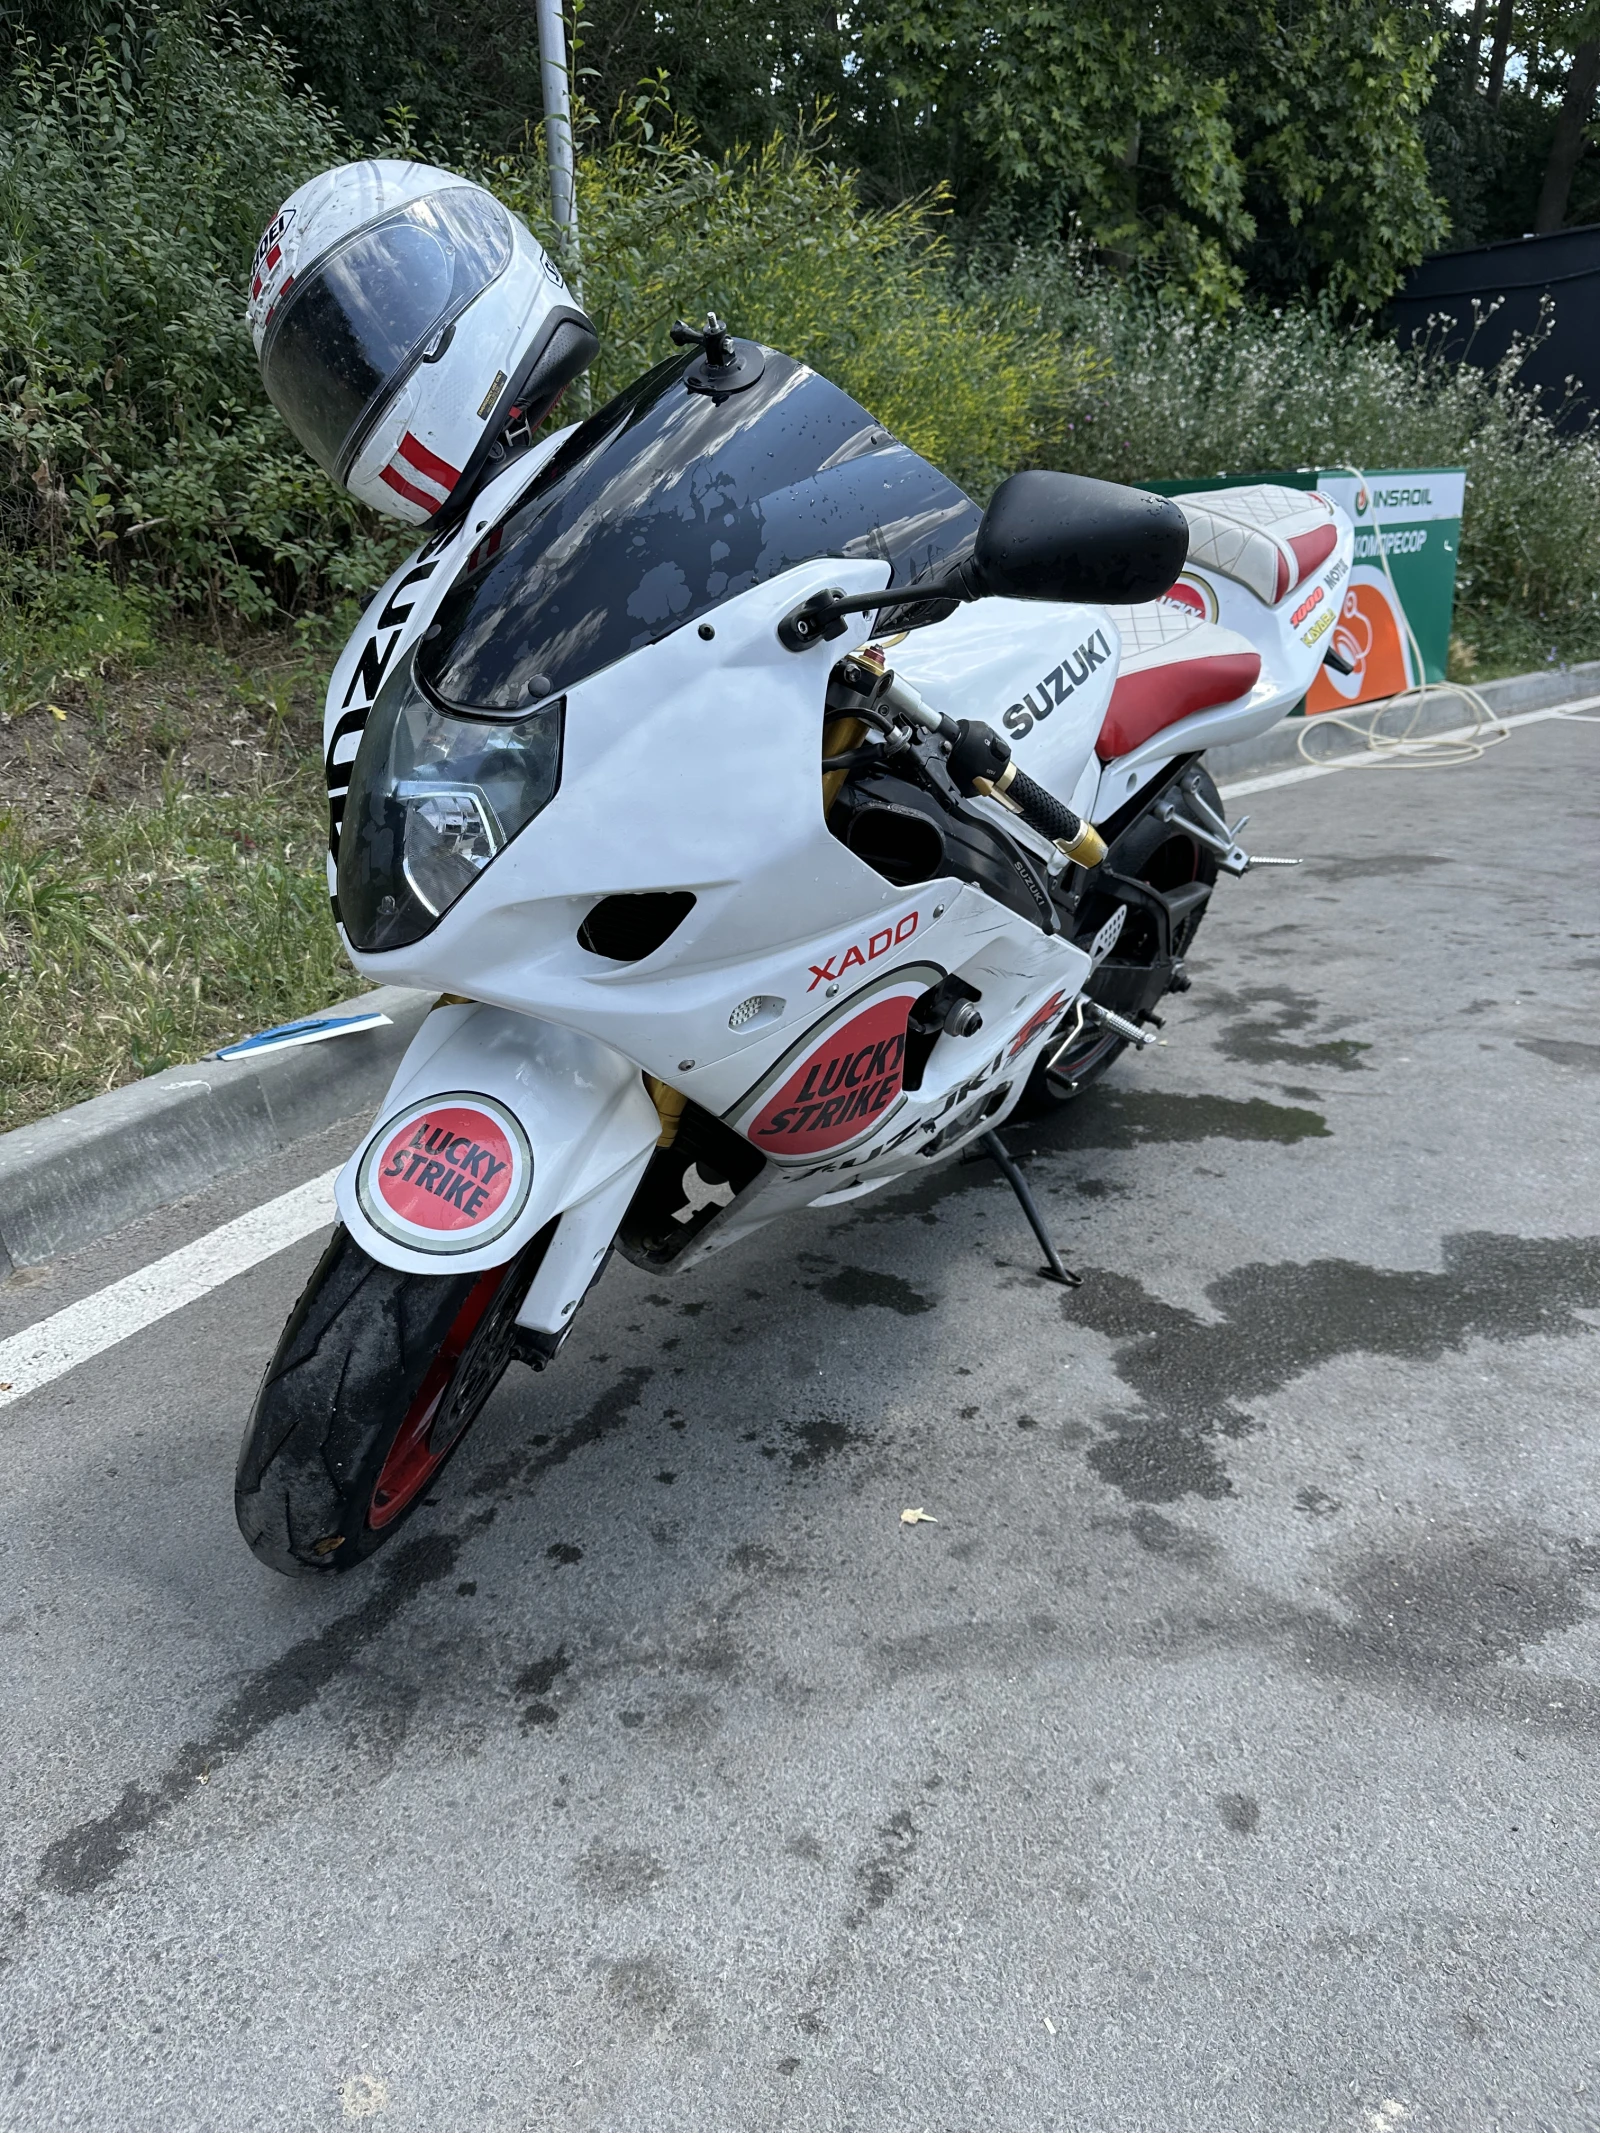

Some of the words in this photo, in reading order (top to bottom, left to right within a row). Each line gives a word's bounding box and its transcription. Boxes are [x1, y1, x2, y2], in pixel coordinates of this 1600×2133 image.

[1290, 586, 1324, 630] 1000
[1002, 628, 1112, 741] SUZUKI
[1014, 861, 1045, 906] SUZUKI
[806, 911, 919, 993] XADO
[757, 1071, 900, 1136] STRIKE
[383, 1149, 490, 1220] STRIKE
[408, 1123, 507, 1186] LUCKY
